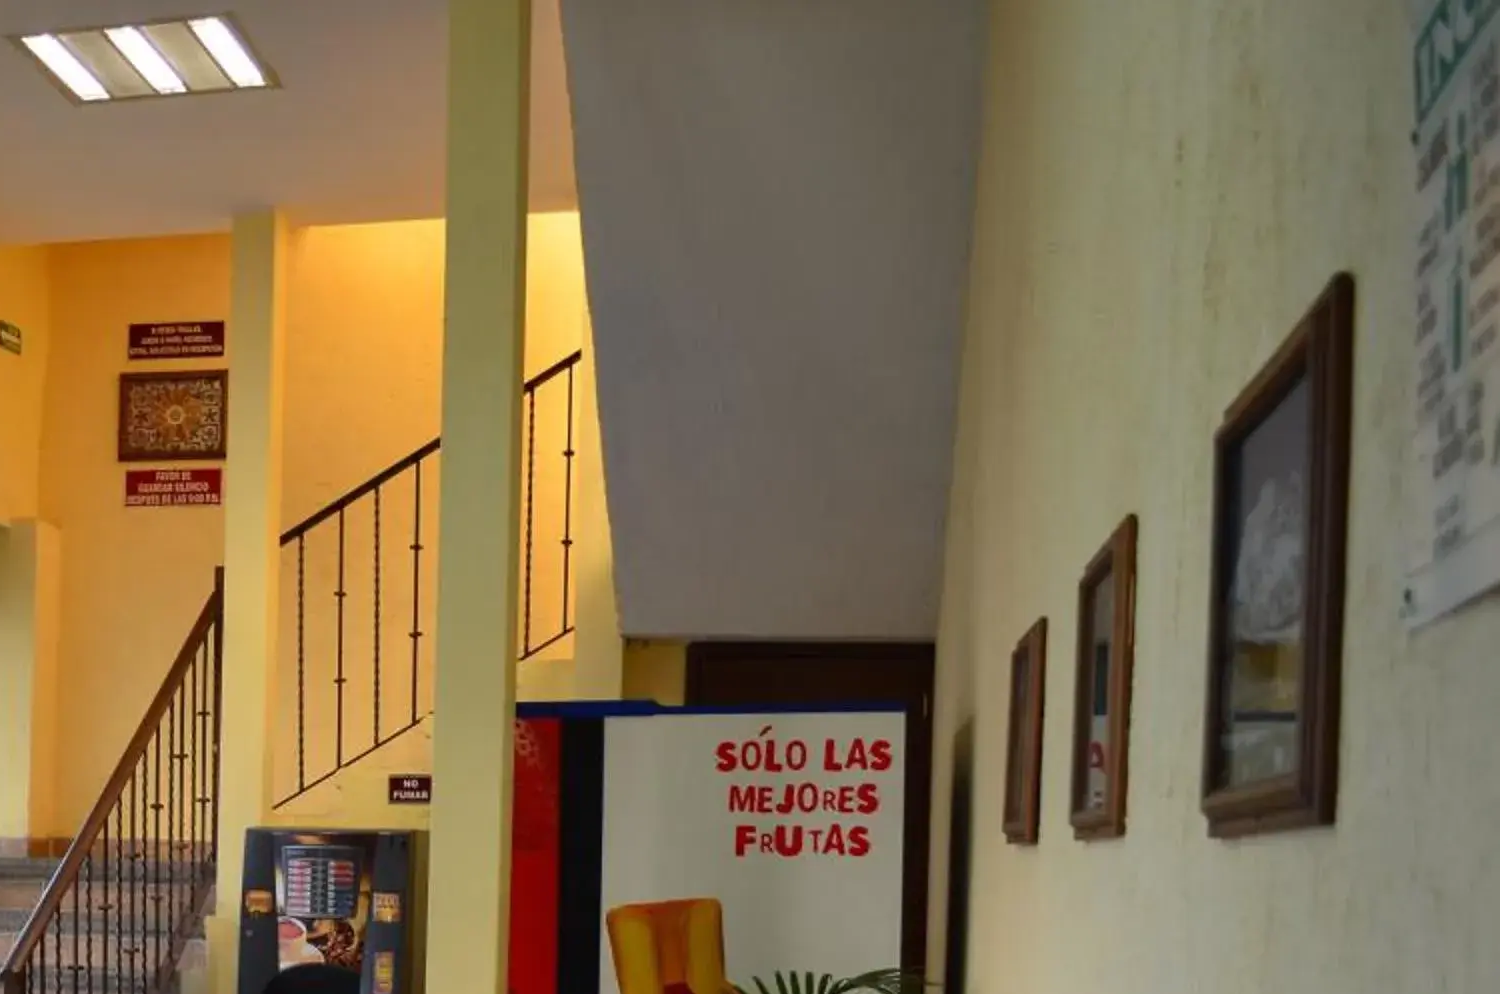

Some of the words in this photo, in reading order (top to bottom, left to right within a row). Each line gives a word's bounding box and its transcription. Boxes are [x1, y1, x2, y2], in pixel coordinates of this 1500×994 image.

[715, 725, 807, 772] SÓLO
[823, 737, 892, 772] LAS
[393, 790, 429, 800] FUMAR
[403, 779, 419, 789] NO
[728, 782, 879, 814] MEJORES
[735, 823, 871, 857] FRUTAS
